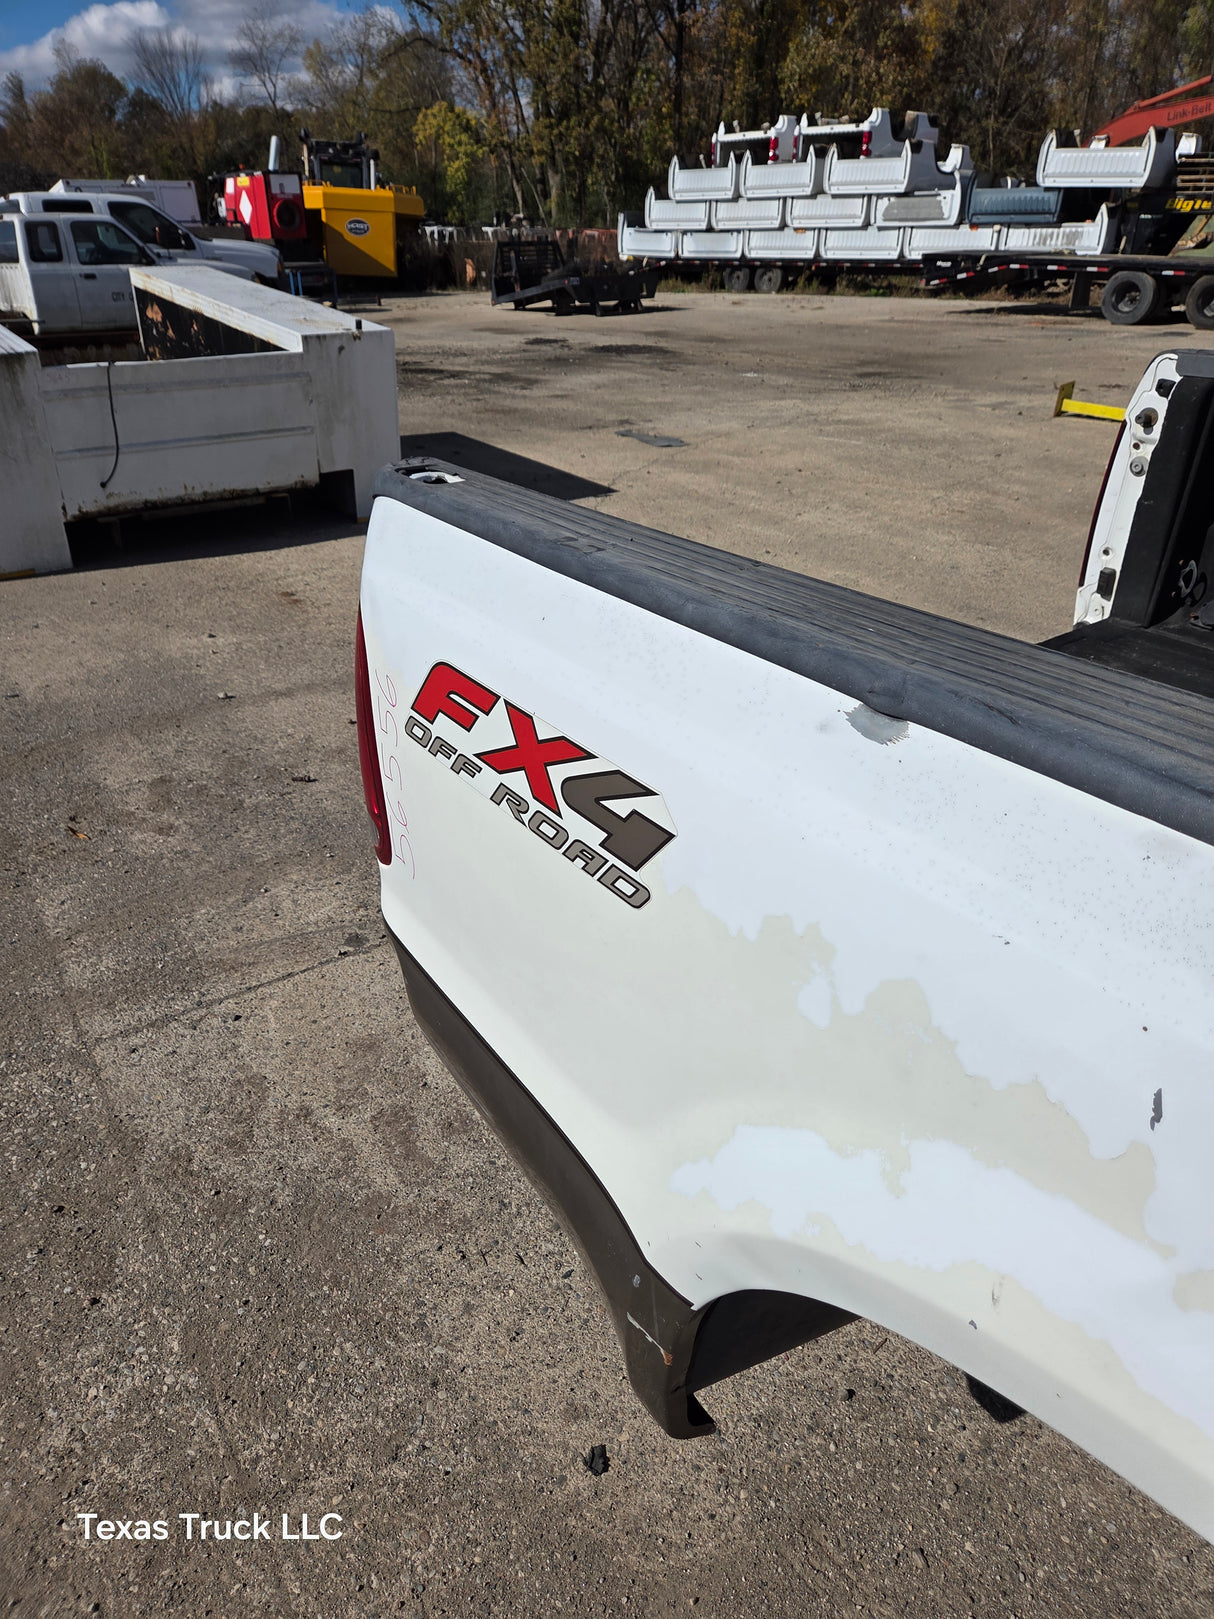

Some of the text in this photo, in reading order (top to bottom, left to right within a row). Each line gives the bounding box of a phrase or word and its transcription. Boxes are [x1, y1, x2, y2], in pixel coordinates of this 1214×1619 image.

[1167, 102, 1212, 121] Link-Belt
[112, 292, 125, 302] CITY
[404, 715, 652, 909] OFF ROAD
[410, 661, 677, 872] FX4
